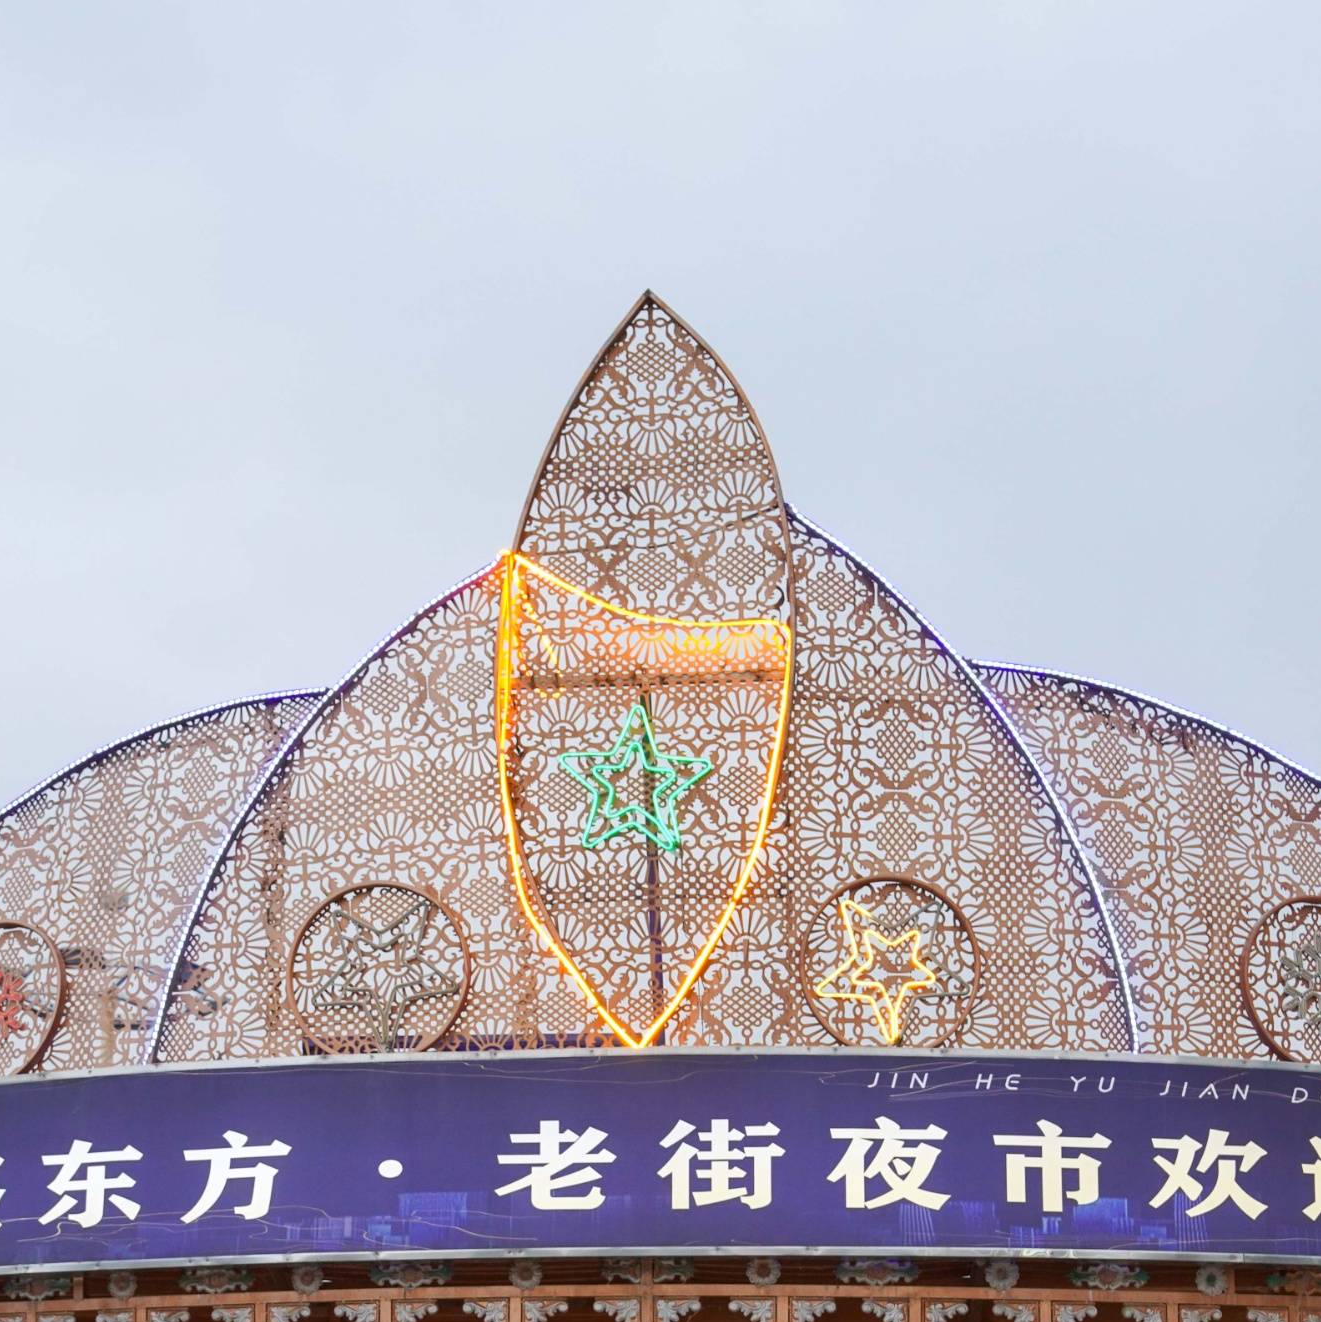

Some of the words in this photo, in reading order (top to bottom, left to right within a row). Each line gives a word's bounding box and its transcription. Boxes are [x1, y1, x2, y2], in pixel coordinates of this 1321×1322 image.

[868, 1072, 930, 1089] JIN
[975, 1073, 1021, 1091] HE
[1069, 1076, 1117, 1094] YU
[1159, 1080, 1251, 1101] JIAN
